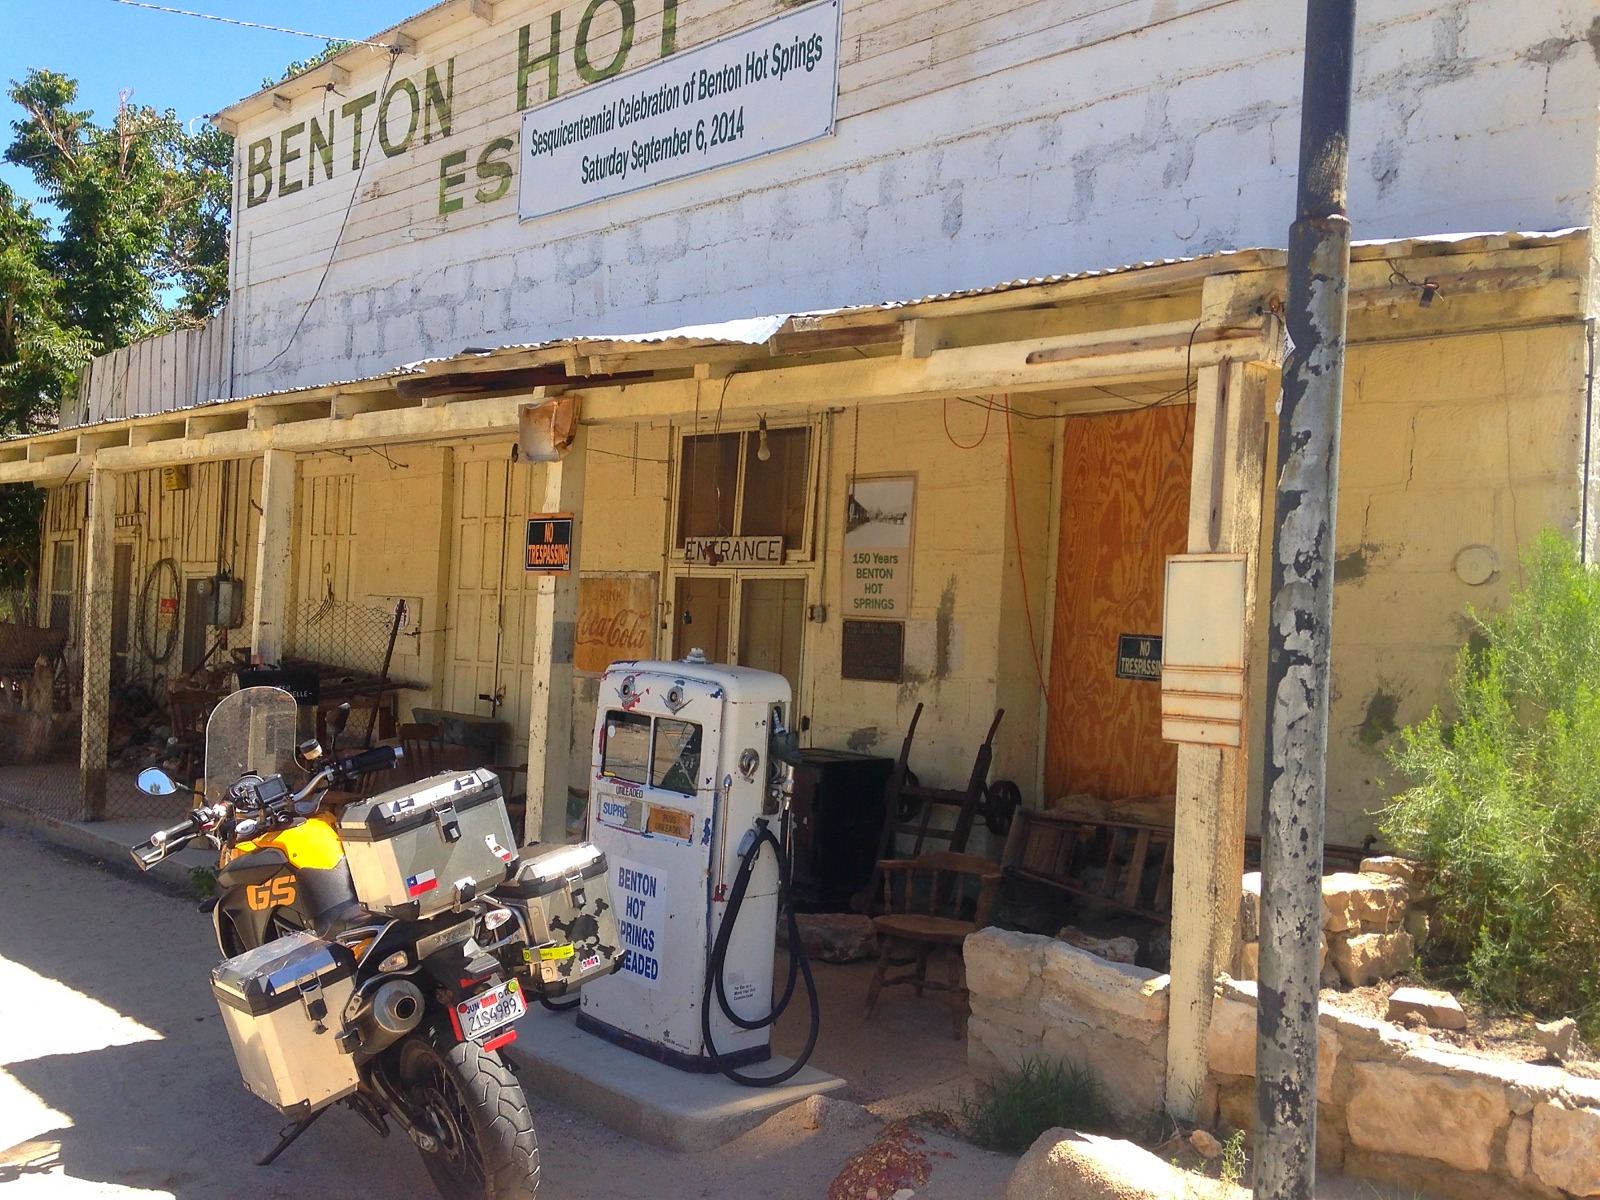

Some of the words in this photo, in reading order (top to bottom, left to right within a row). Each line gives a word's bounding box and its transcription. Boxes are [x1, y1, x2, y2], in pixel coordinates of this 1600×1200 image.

[530, 101, 617, 156] Sesquicentennial
[617, 82, 680, 127] Celebration
[682, 77, 697, 104] of
[697, 60, 743, 101] Benton
[745, 49, 768, 85] Hot
[770, 32, 823, 82] Springs
[247, 57, 455, 208] BENTON
[580, 144, 630, 185] Saturday
[630, 126, 693, 173] September
[695, 119, 707, 155] 6,
[709, 105, 745, 146] 2014
[438, 131, 521, 215] ES
[544, 522, 554, 543] NO
[528, 543, 569, 565] TRESPASSING
[852, 552, 871, 564] 150
[872, 552, 899, 564] Years
[856, 567, 893, 579] BENTON
[864, 582, 883, 594] HOT
[853, 597, 895, 610] SPRINGS
[575, 607, 651, 649] Coca-Cola
[1139, 640, 1151, 657] NO
[1121, 657, 1162, 675] TRESPASSIN
[246, 874, 297, 911] GS
[618, 866, 657, 899] BENTON
[625, 895, 646, 921] HOT
[617, 918, 655, 952] PRINGS
[467, 1001, 480, 1014] JUN
[468, 997, 517, 1032] 21S4989
